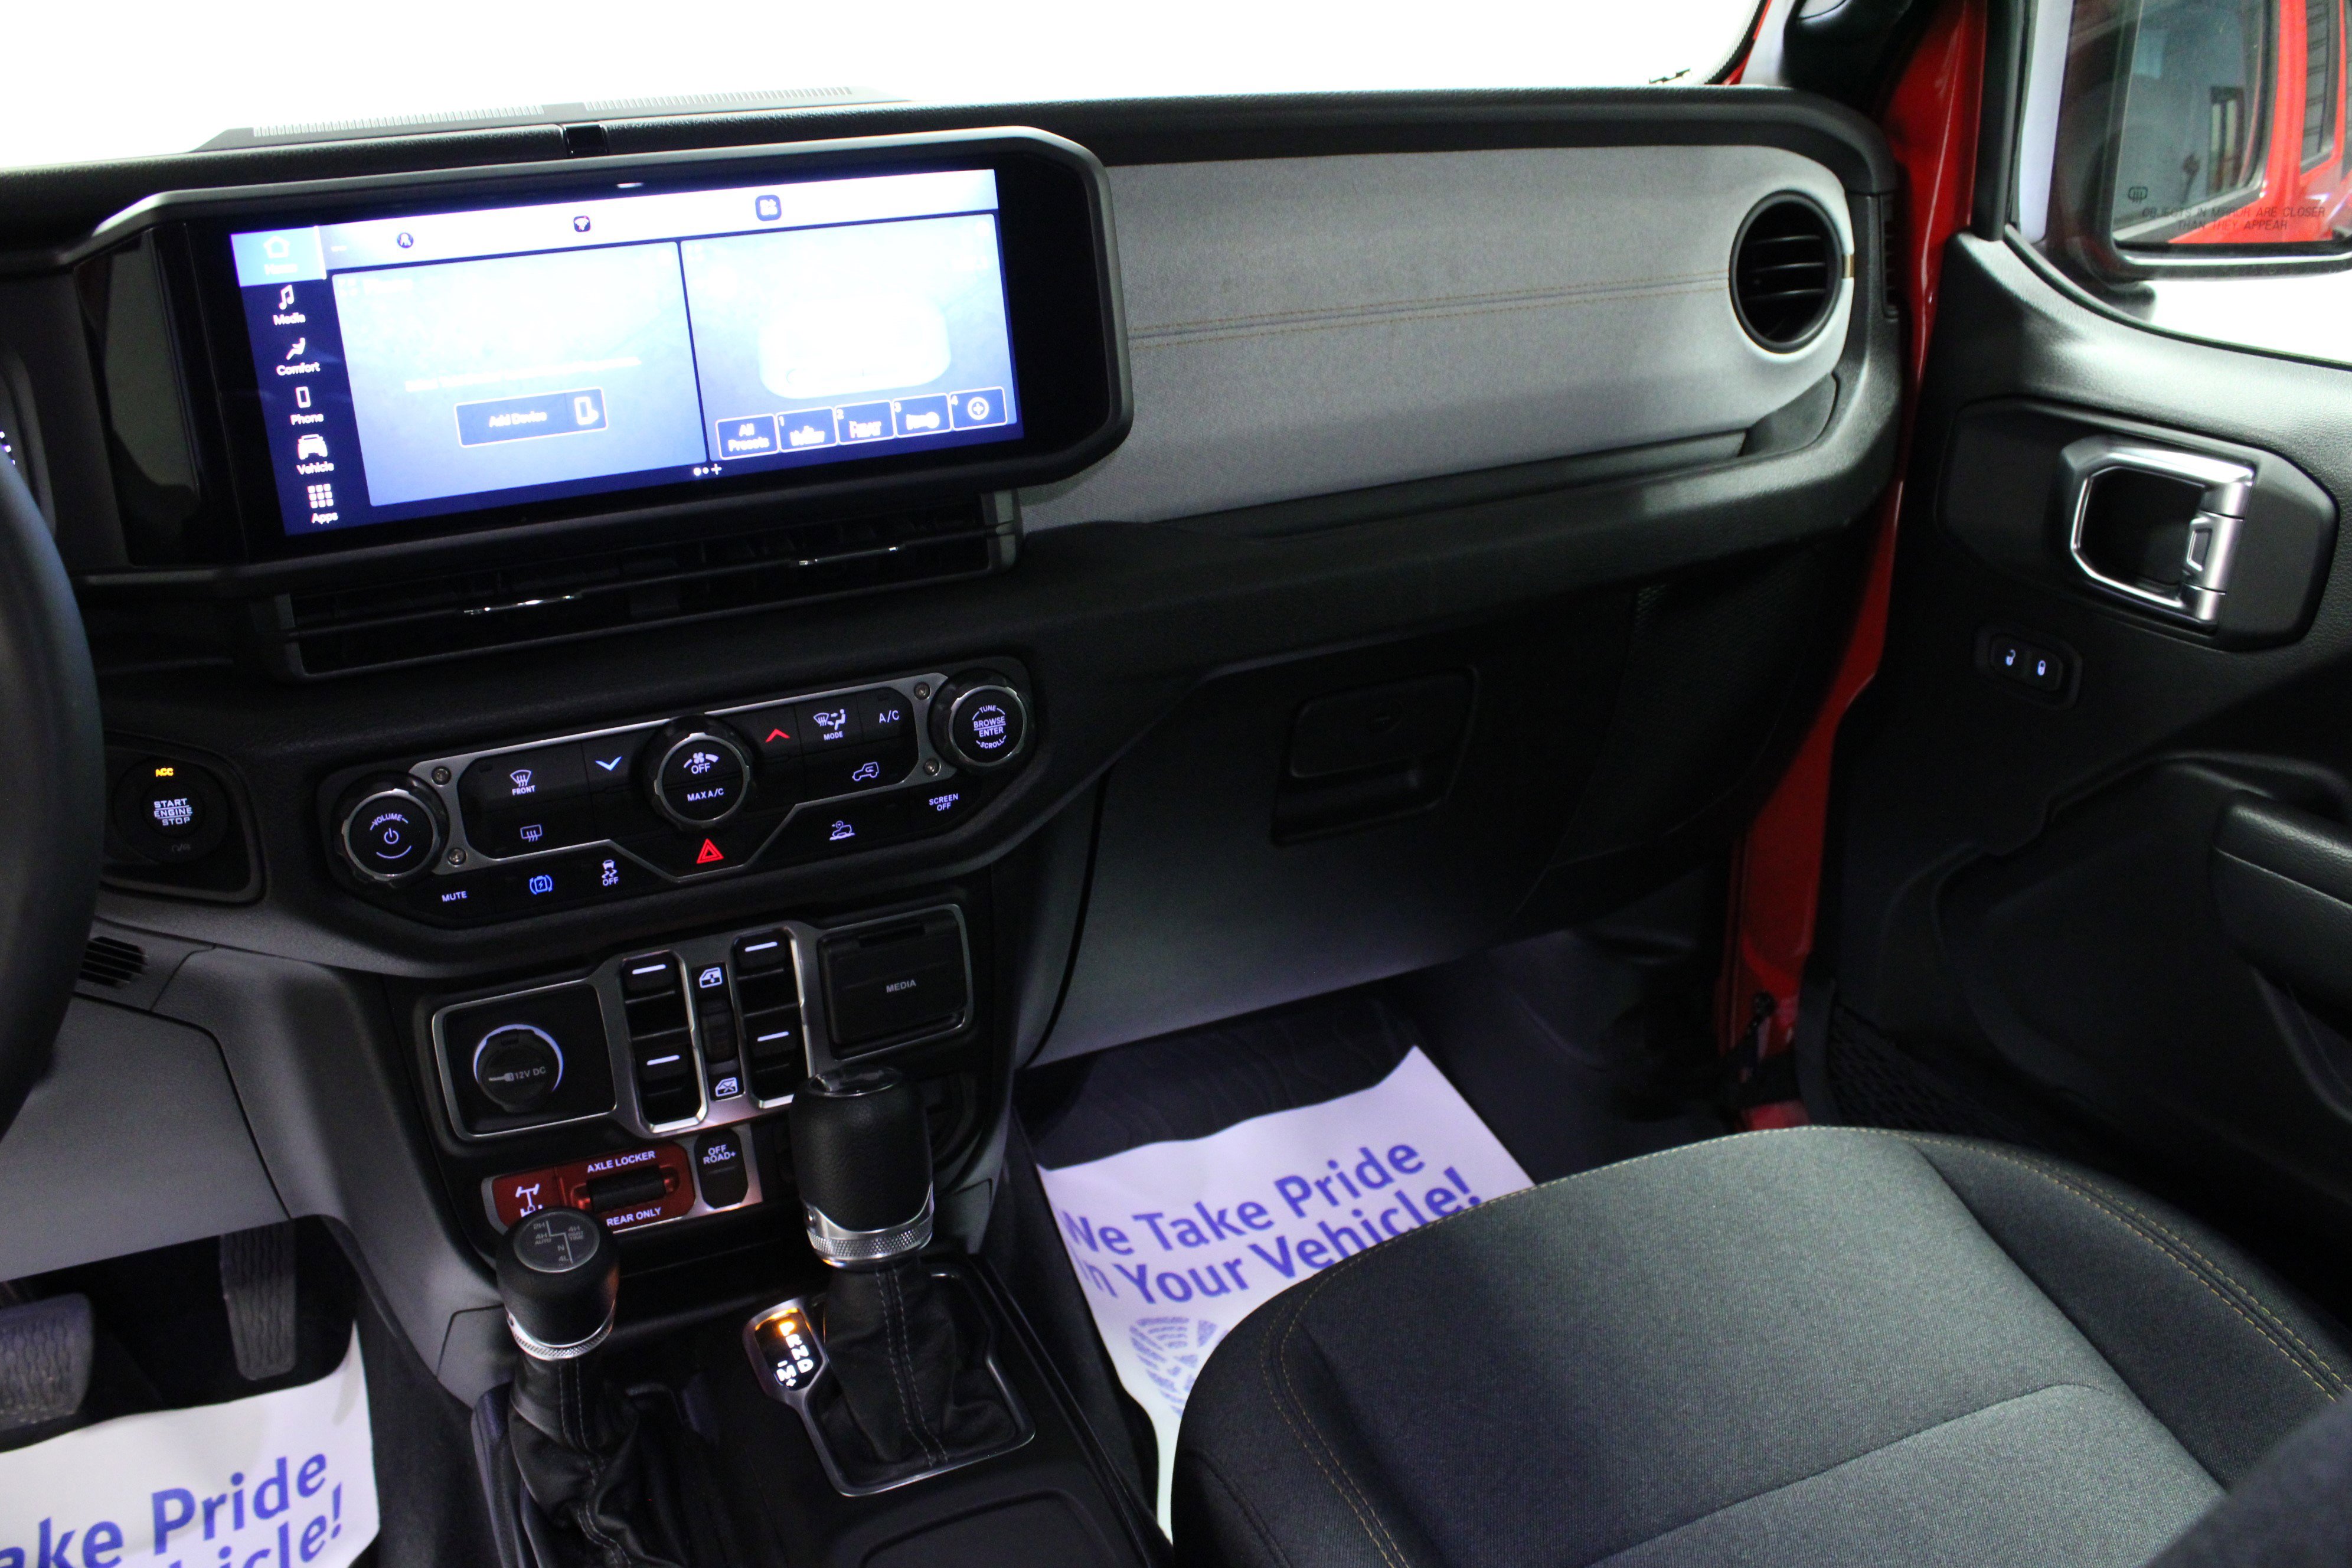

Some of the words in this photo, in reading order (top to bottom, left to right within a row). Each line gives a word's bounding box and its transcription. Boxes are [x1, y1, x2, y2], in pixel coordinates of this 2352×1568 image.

[2142, 207, 2191, 218] OBJECTS
[2197, 207, 2206, 217] IN
[2210, 207, 2250, 217] MIRROR
[2256, 207, 2278, 217] ARE
[2283, 207, 2325, 217] CLOSER
[2177, 220, 2204, 229] THAN
[2245, 220, 2287, 230] APPEAR
[273, 312, 305, 325] Media
[276, 361, 320, 375] Comfort
[894, 401, 901, 411] 3
[290, 413, 324, 424] Phone
[836, 409, 844, 419] 2
[779, 416, 784, 426] 1
[739, 423, 754, 436] All
[296, 461, 334, 474] Vehicle
[311, 512, 338, 524] Apps
[979, 704, 996, 713] TUNE
[878, 710, 899, 723] A/C
[974, 716, 1005, 728] BROWSE
[823, 730, 843, 740] MODE
[979, 726, 1003, 737] ENTER
[979, 738, 1004, 749] SCROLL
[691, 762, 710, 774] OFF
[512, 785, 535, 795] FRONT
[687, 791, 706, 802] MAX
[707, 788, 724, 798] A/C
[153, 798, 187, 808] START
[929, 793, 958, 805] SCREEN
[153, 806, 192, 817] ENGINE
[936, 802, 950, 811] OFF
[162, 816, 190, 825] STOP
[372, 812, 402, 825] VOLUME
[602, 877, 618, 886] OFF
[442, 890, 467, 902] MUTE
[886, 979, 916, 992] MEDIA
[515, 1069, 530, 1079] 12V
[533, 1066, 545, 1076] DC
[708, 1144, 726, 1157] OFF
[587, 1159, 613, 1173] AXLE
[615, 1150, 655, 1167] LOCKER
[1131, 1200, 1275, 1251] Take
[1273, 1144, 1425, 1219] Pride
[606, 1212, 633, 1227] REAR
[635, 1207, 662, 1221] ONLY
[1112, 1257, 1249, 1305] Your
[1247, 1165, 1482, 1279] Vehicle!
[785, 1333, 802, 1348] R
[791, 1344, 809, 1360] N
[797, 1358, 814, 1373] D
[776, 1364, 796, 1381] M
[152, 1453, 326, 1556] Pride
